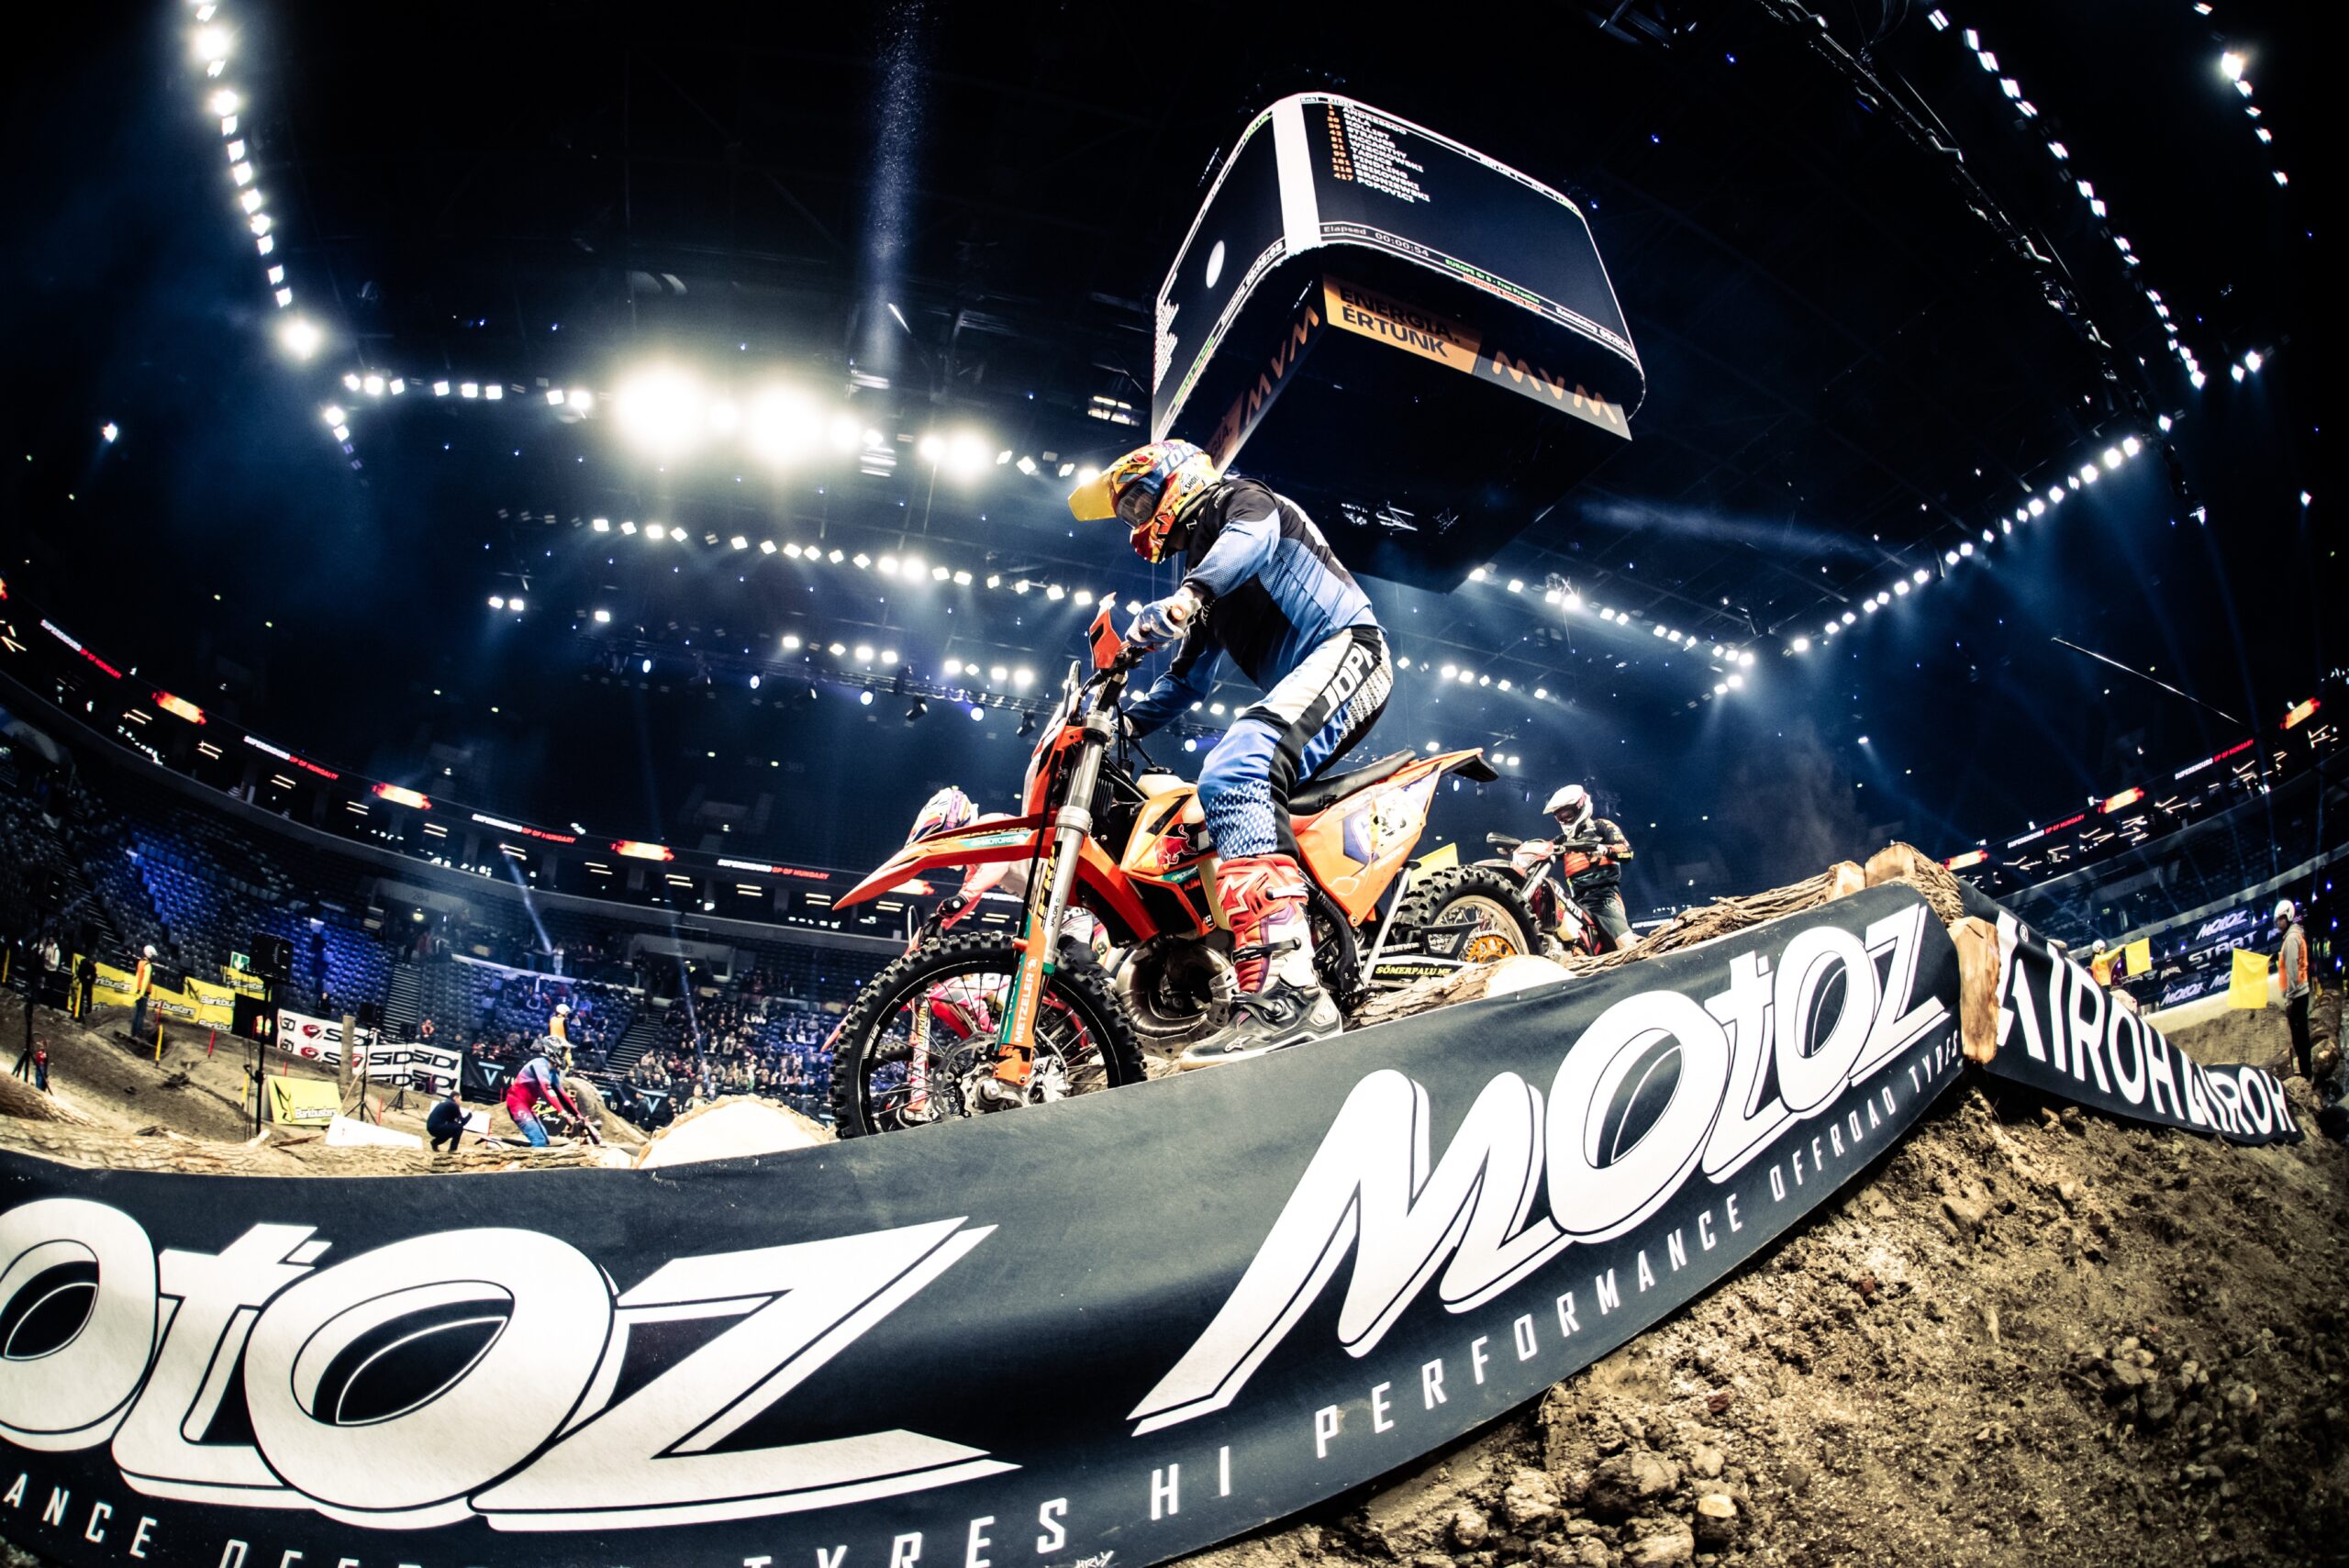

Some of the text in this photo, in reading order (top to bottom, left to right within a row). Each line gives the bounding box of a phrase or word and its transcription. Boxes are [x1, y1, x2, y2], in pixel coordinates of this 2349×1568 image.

[1323, 225, 1430, 257] Elapsed 00:00:54
[2188, 930, 2257, 965] START
[1013, 972, 1035, 1043] METZELER
[1150, 1029, 1959, 1521] HI PERFORMANCE OFFROAD TYRES
